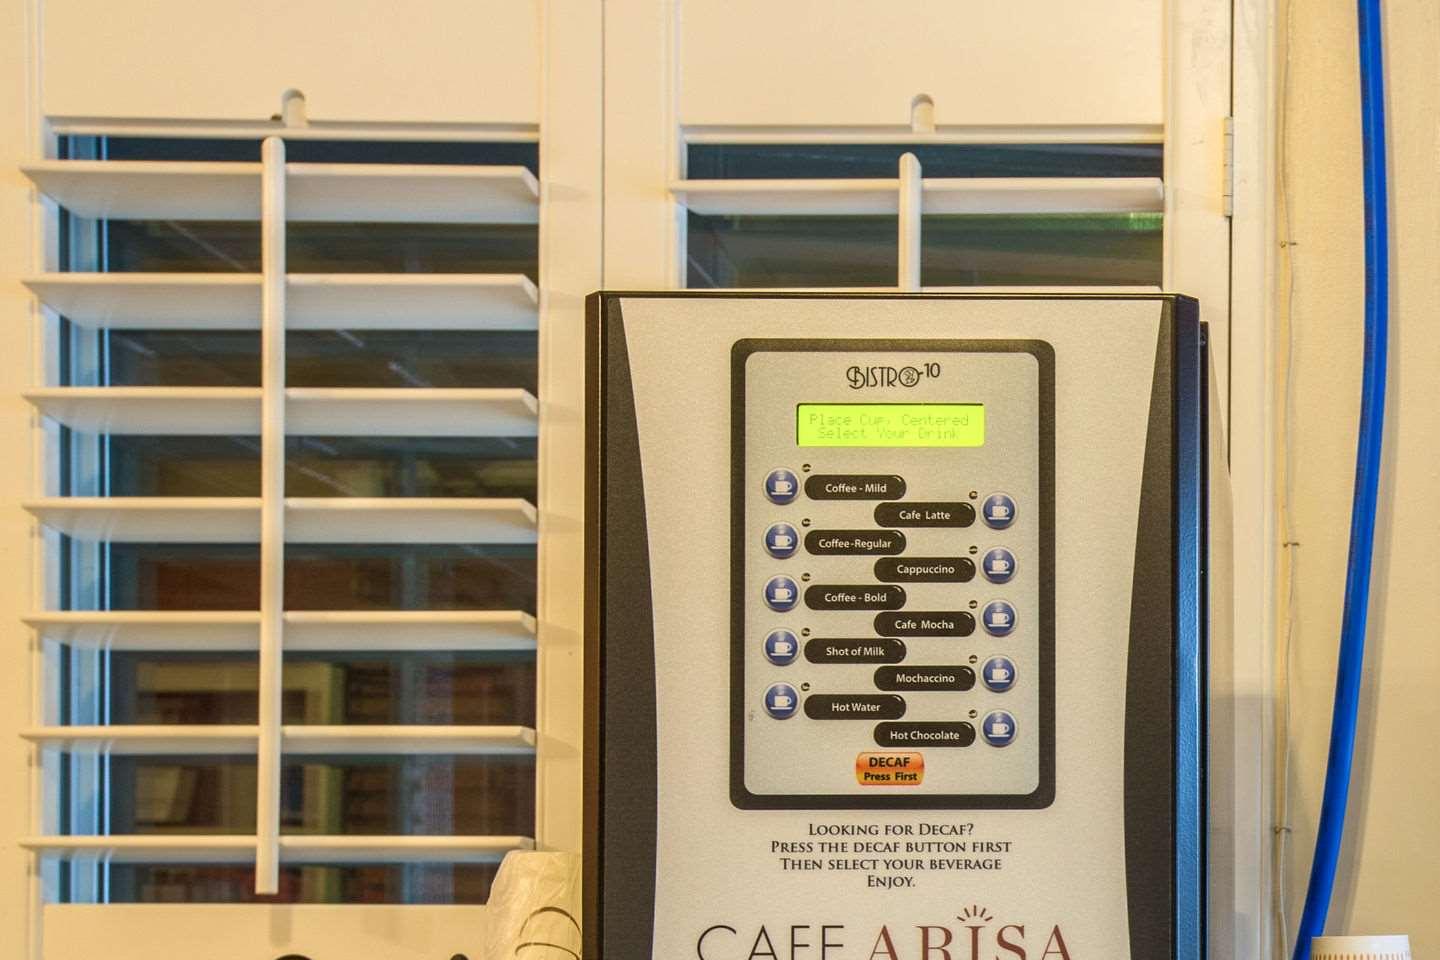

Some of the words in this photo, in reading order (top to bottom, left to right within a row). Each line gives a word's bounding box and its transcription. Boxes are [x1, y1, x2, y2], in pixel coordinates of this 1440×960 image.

[846, 366, 921, 390] BISTRO
[809, 413, 851, 426] Place
[902, 413, 969, 426] Centered
[817, 427, 867, 439] Select
[918, 427, 959, 439] Drink
[825, 482, 857, 493] Coffee
[865, 482, 887, 493] Mild
[899, 510, 921, 520] Cafe
[925, 510, 951, 520] Latte
[897, 564, 955, 576] Cappuccino
[824, 592, 857, 602] Coffee
[864, 592, 887, 602] Bold
[895, 619, 917, 630] Cafe
[921, 619, 954, 630] Mocha
[826, 646, 848, 657] Shot
[850, 646, 862, 657] of
[863, 646, 885, 657] Milk
[896, 673, 955, 683] Mochaccino
[831, 702, 850, 712] Hot
[851, 702, 881, 712] Water
[890, 730, 909, 741] Hot
[910, 730, 960, 741] Chocolate
[869, 757, 911, 768] DECAF
[864, 772, 891, 782] Press
[895, 772, 918, 782] First
[808, 823, 879, 836] LOOKING
[884, 823, 914, 836] FOR
[771, 840, 813, 853] PRESS
[818, 840, 849, 853] THE
[854, 840, 900, 853] DECAF
[906, 840, 966, 853] BUTTON
[972, 840, 1012, 853] FIRST
[780, 858, 823, 871] THEN
[828, 858, 879, 871] SELECT
[883, 858, 925, 871] YOUR
[930, 858, 1001, 871] BEVERAGE
